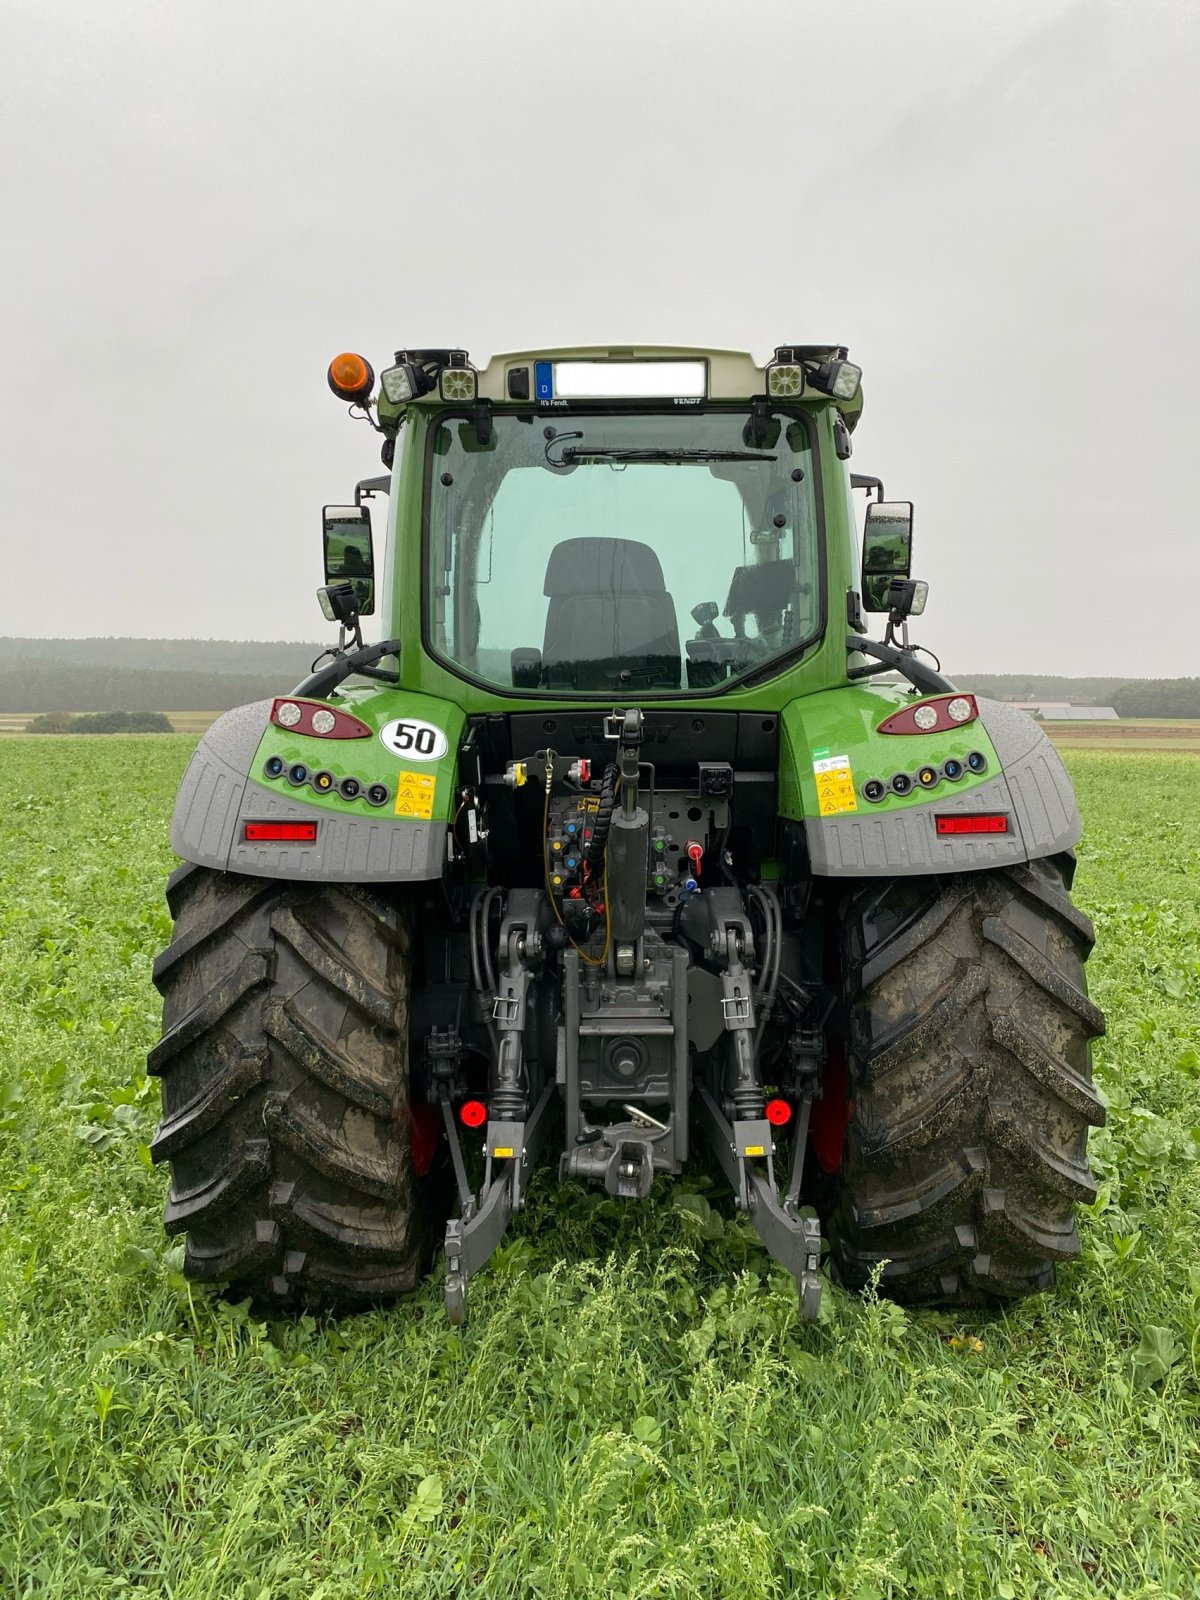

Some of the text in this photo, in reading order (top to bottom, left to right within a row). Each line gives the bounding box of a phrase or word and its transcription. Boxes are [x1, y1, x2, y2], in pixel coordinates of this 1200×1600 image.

[541, 384, 548, 393] D
[673, 397, 702, 405] FENDT
[393, 723, 436, 754] 50
[571, 724, 677, 745] FEDT
